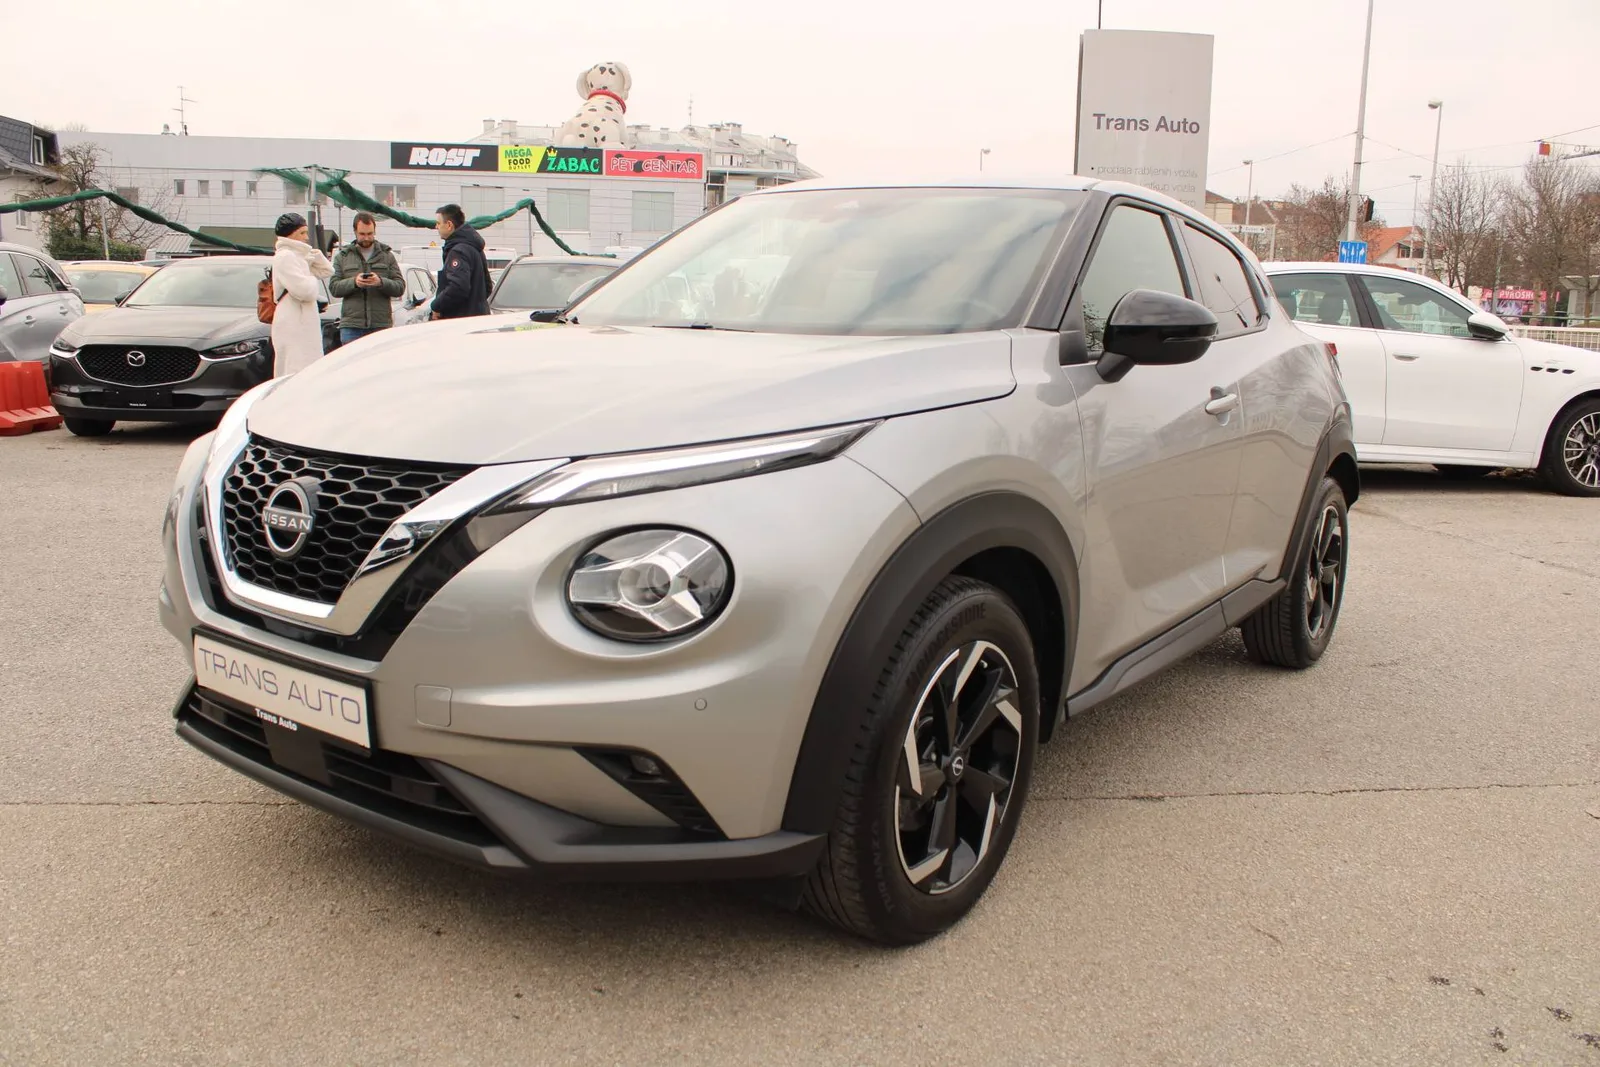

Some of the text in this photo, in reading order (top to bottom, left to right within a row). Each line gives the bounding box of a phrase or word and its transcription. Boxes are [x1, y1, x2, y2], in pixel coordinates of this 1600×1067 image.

[1092, 113, 1200, 134] Trans Auto
[408, 146, 481, 167] ROST
[504, 148, 532, 159] MEGA
[508, 158, 531, 166] FOOD
[610, 157, 698, 174] PET CENTAR
[263, 509, 311, 530] NISSAN
[198, 647, 361, 725] TRANS AUTO
[255, 708, 298, 731] Trans Auto
